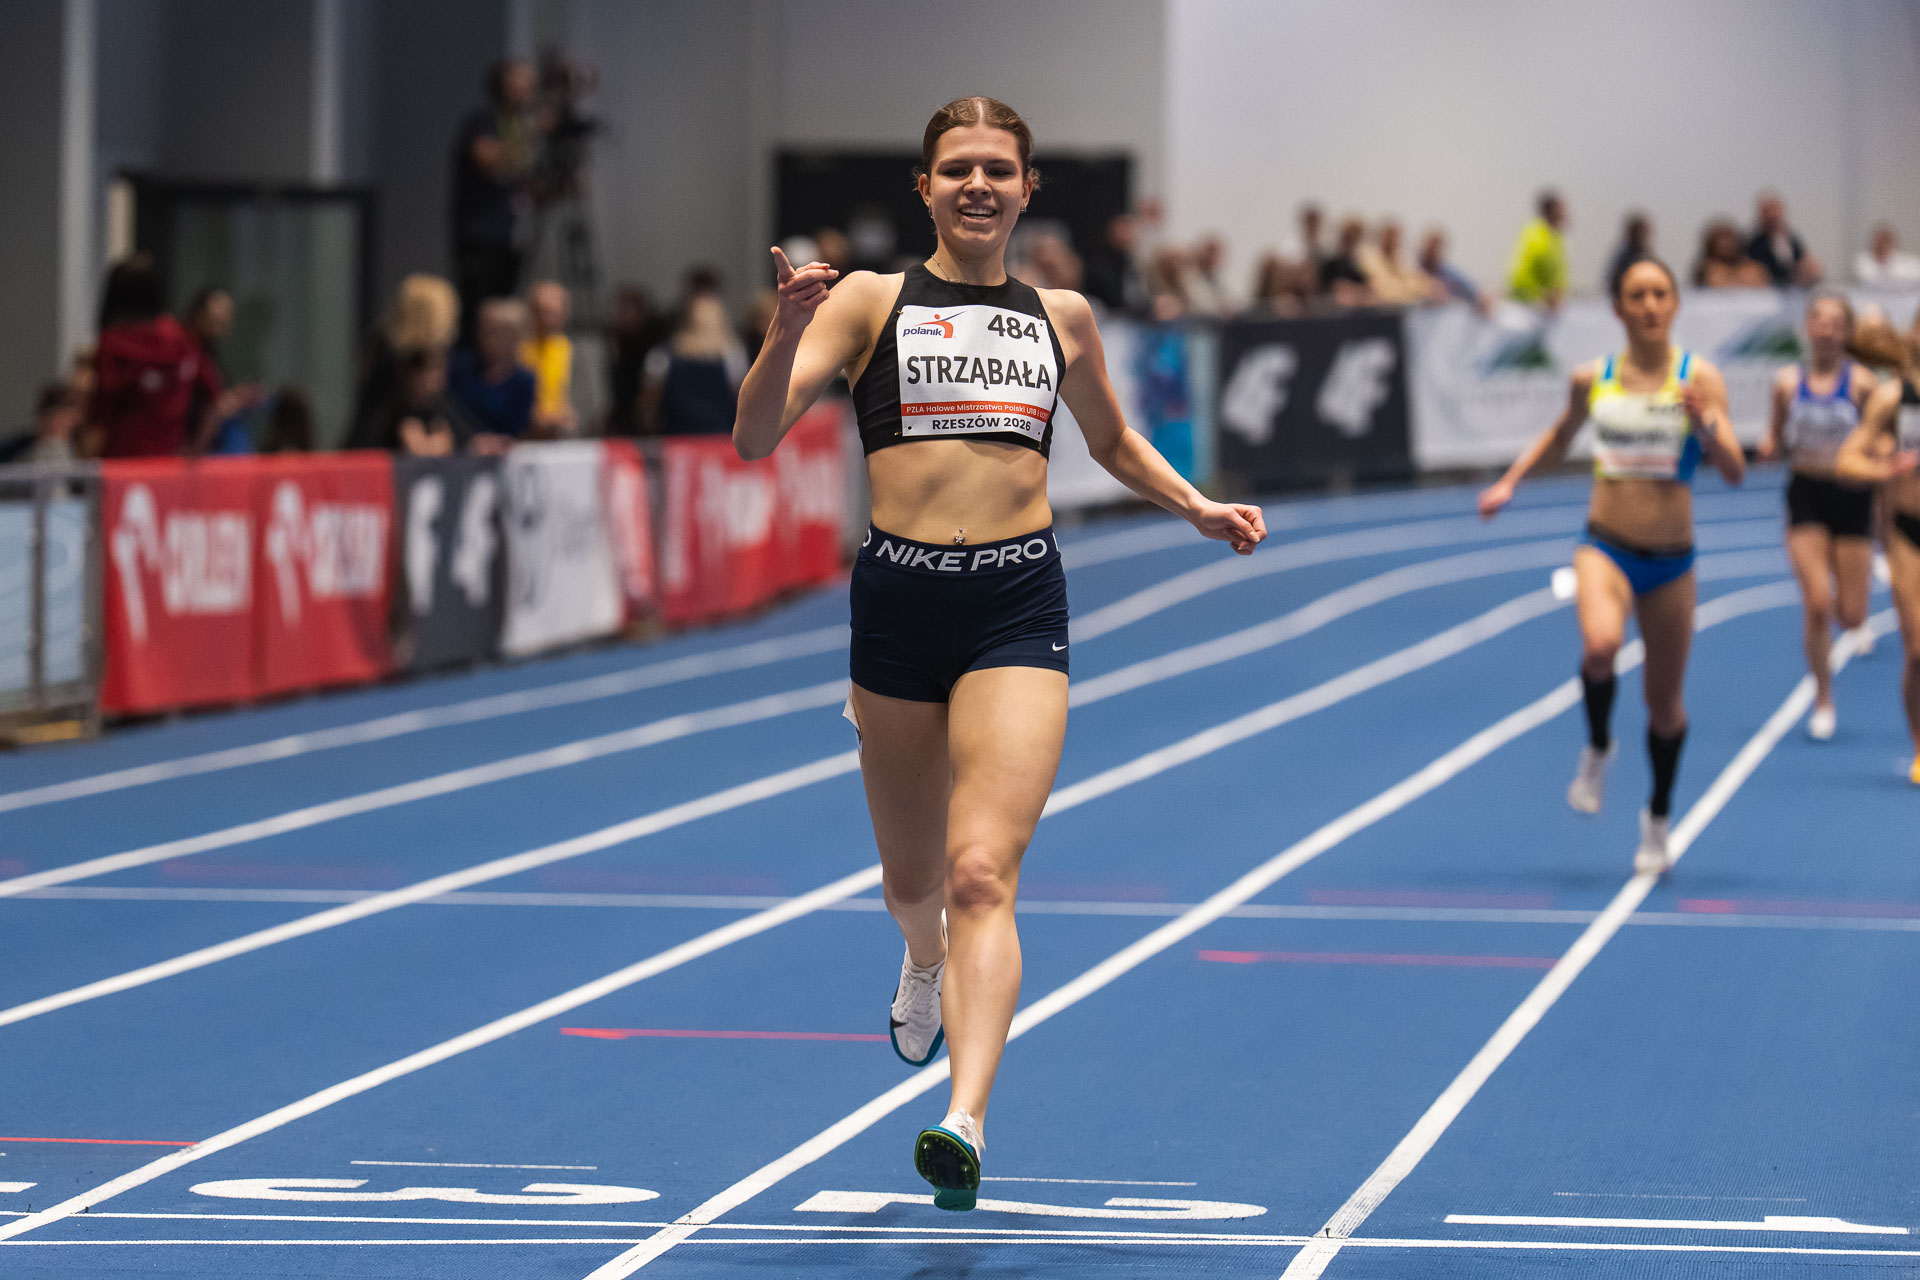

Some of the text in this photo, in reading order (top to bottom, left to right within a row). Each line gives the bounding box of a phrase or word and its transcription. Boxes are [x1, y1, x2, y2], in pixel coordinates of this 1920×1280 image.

[902, 326, 942, 337] polanik
[987, 314, 1040, 343] 484
[906, 355, 1052, 392] STRZĄBAŁA
[932, 415, 1031, 431] RZESZÓW 2026
[956, 403, 1003, 411] Mistrzostwa
[1004, 403, 1025, 412] Polski
[1026, 407, 1037, 415] U18
[875, 539, 967, 572] NIKE
[970, 538, 1048, 572] PRO
[188, 1178, 661, 1205] 3
[792, 1190, 1268, 1220] 2
